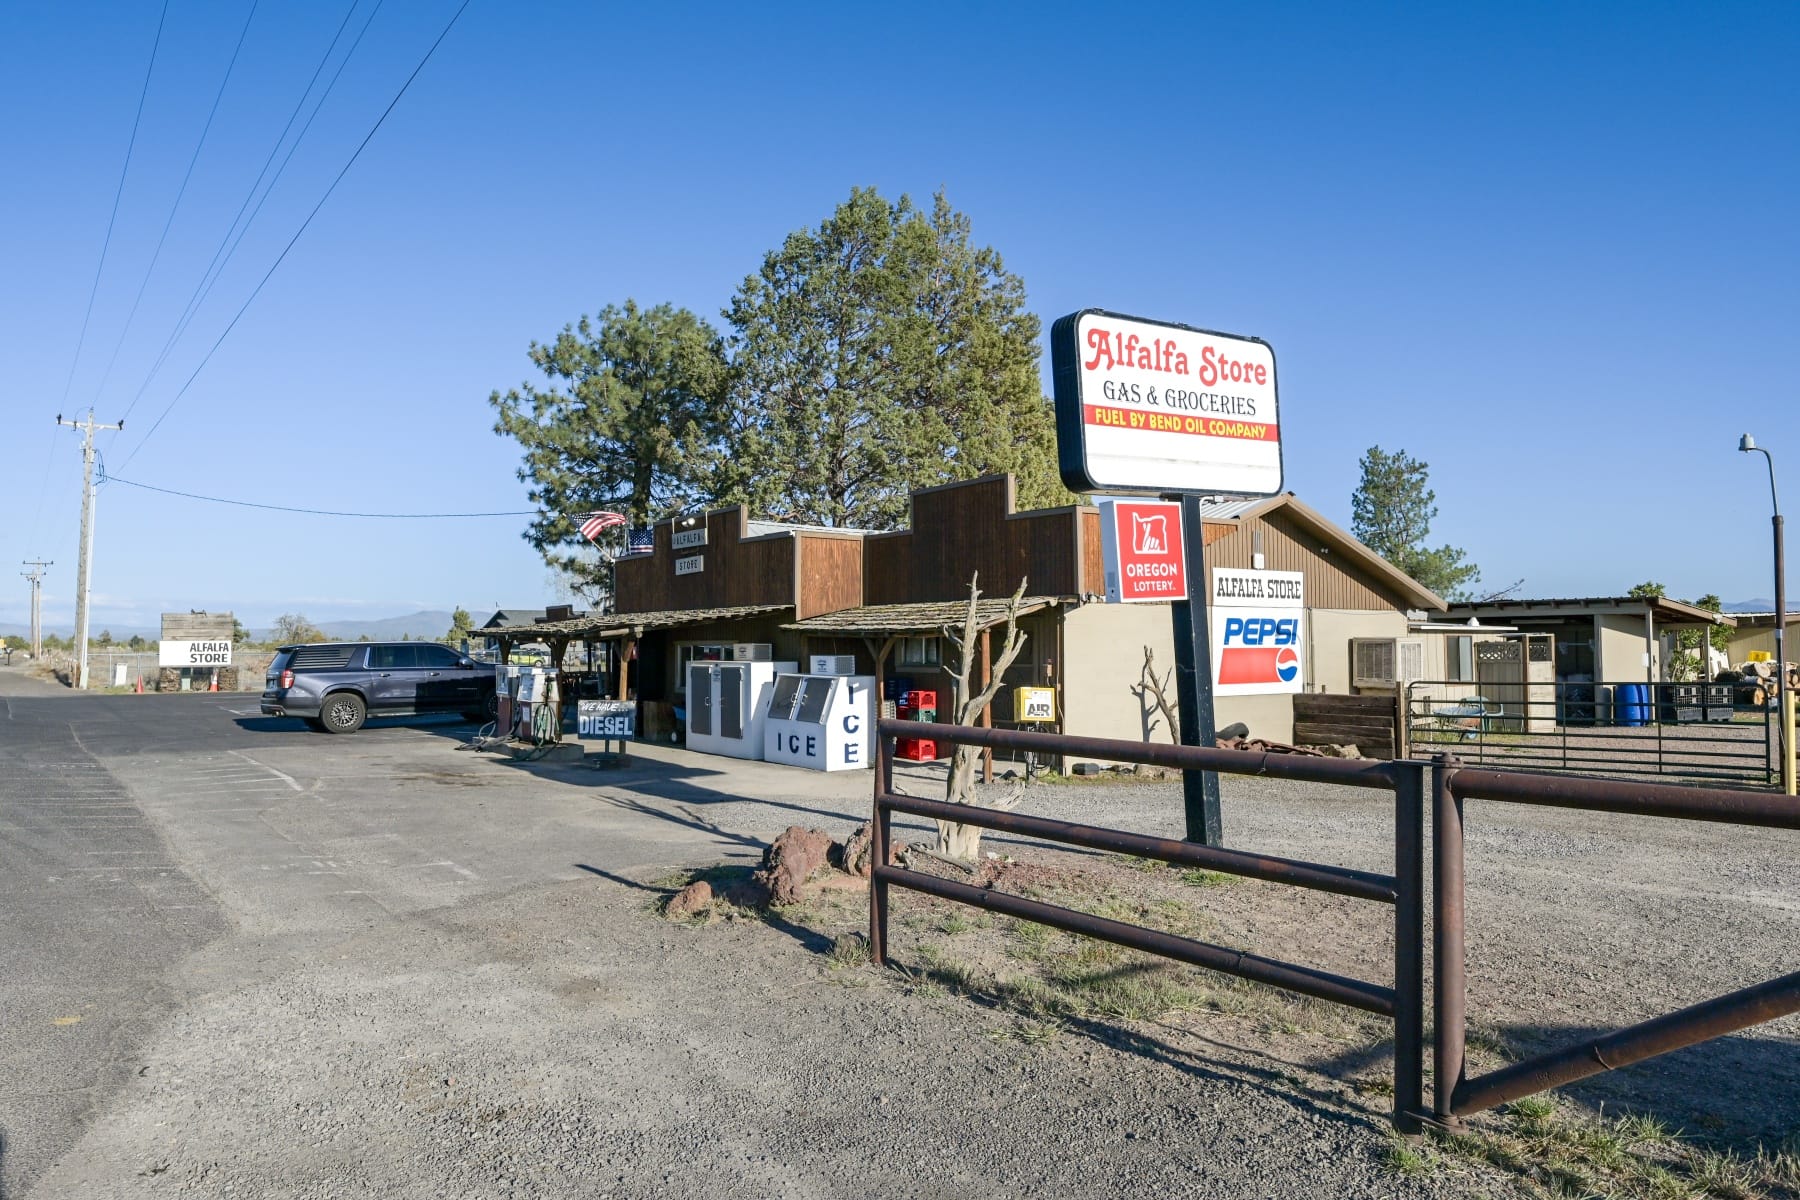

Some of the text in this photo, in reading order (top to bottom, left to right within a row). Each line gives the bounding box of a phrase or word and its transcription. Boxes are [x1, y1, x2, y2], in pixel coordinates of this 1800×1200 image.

[1085, 328, 1267, 387] Alfalfa Store
[1103, 380, 1257, 416] GAS & GROCERIES
[1095, 408, 1267, 439] FUEL BY BEND OIL COMPANY
[679, 559, 698, 571] STORE
[1126, 562, 1178, 577] OREGON
[1133, 580, 1174, 592] LOTTERY
[1216, 577, 1302, 600] ALFALFA STORE
[1223, 617, 1299, 646] PEPSI
[189, 642, 230, 653] ALFALFA
[189, 653, 229, 664] STORE
[581, 702, 597, 711] WE
[1026, 703, 1051, 717] AIR
[579, 716, 633, 736] DIESEL
[842, 685, 860, 764] ICE
[777, 732, 817, 757] ICE
